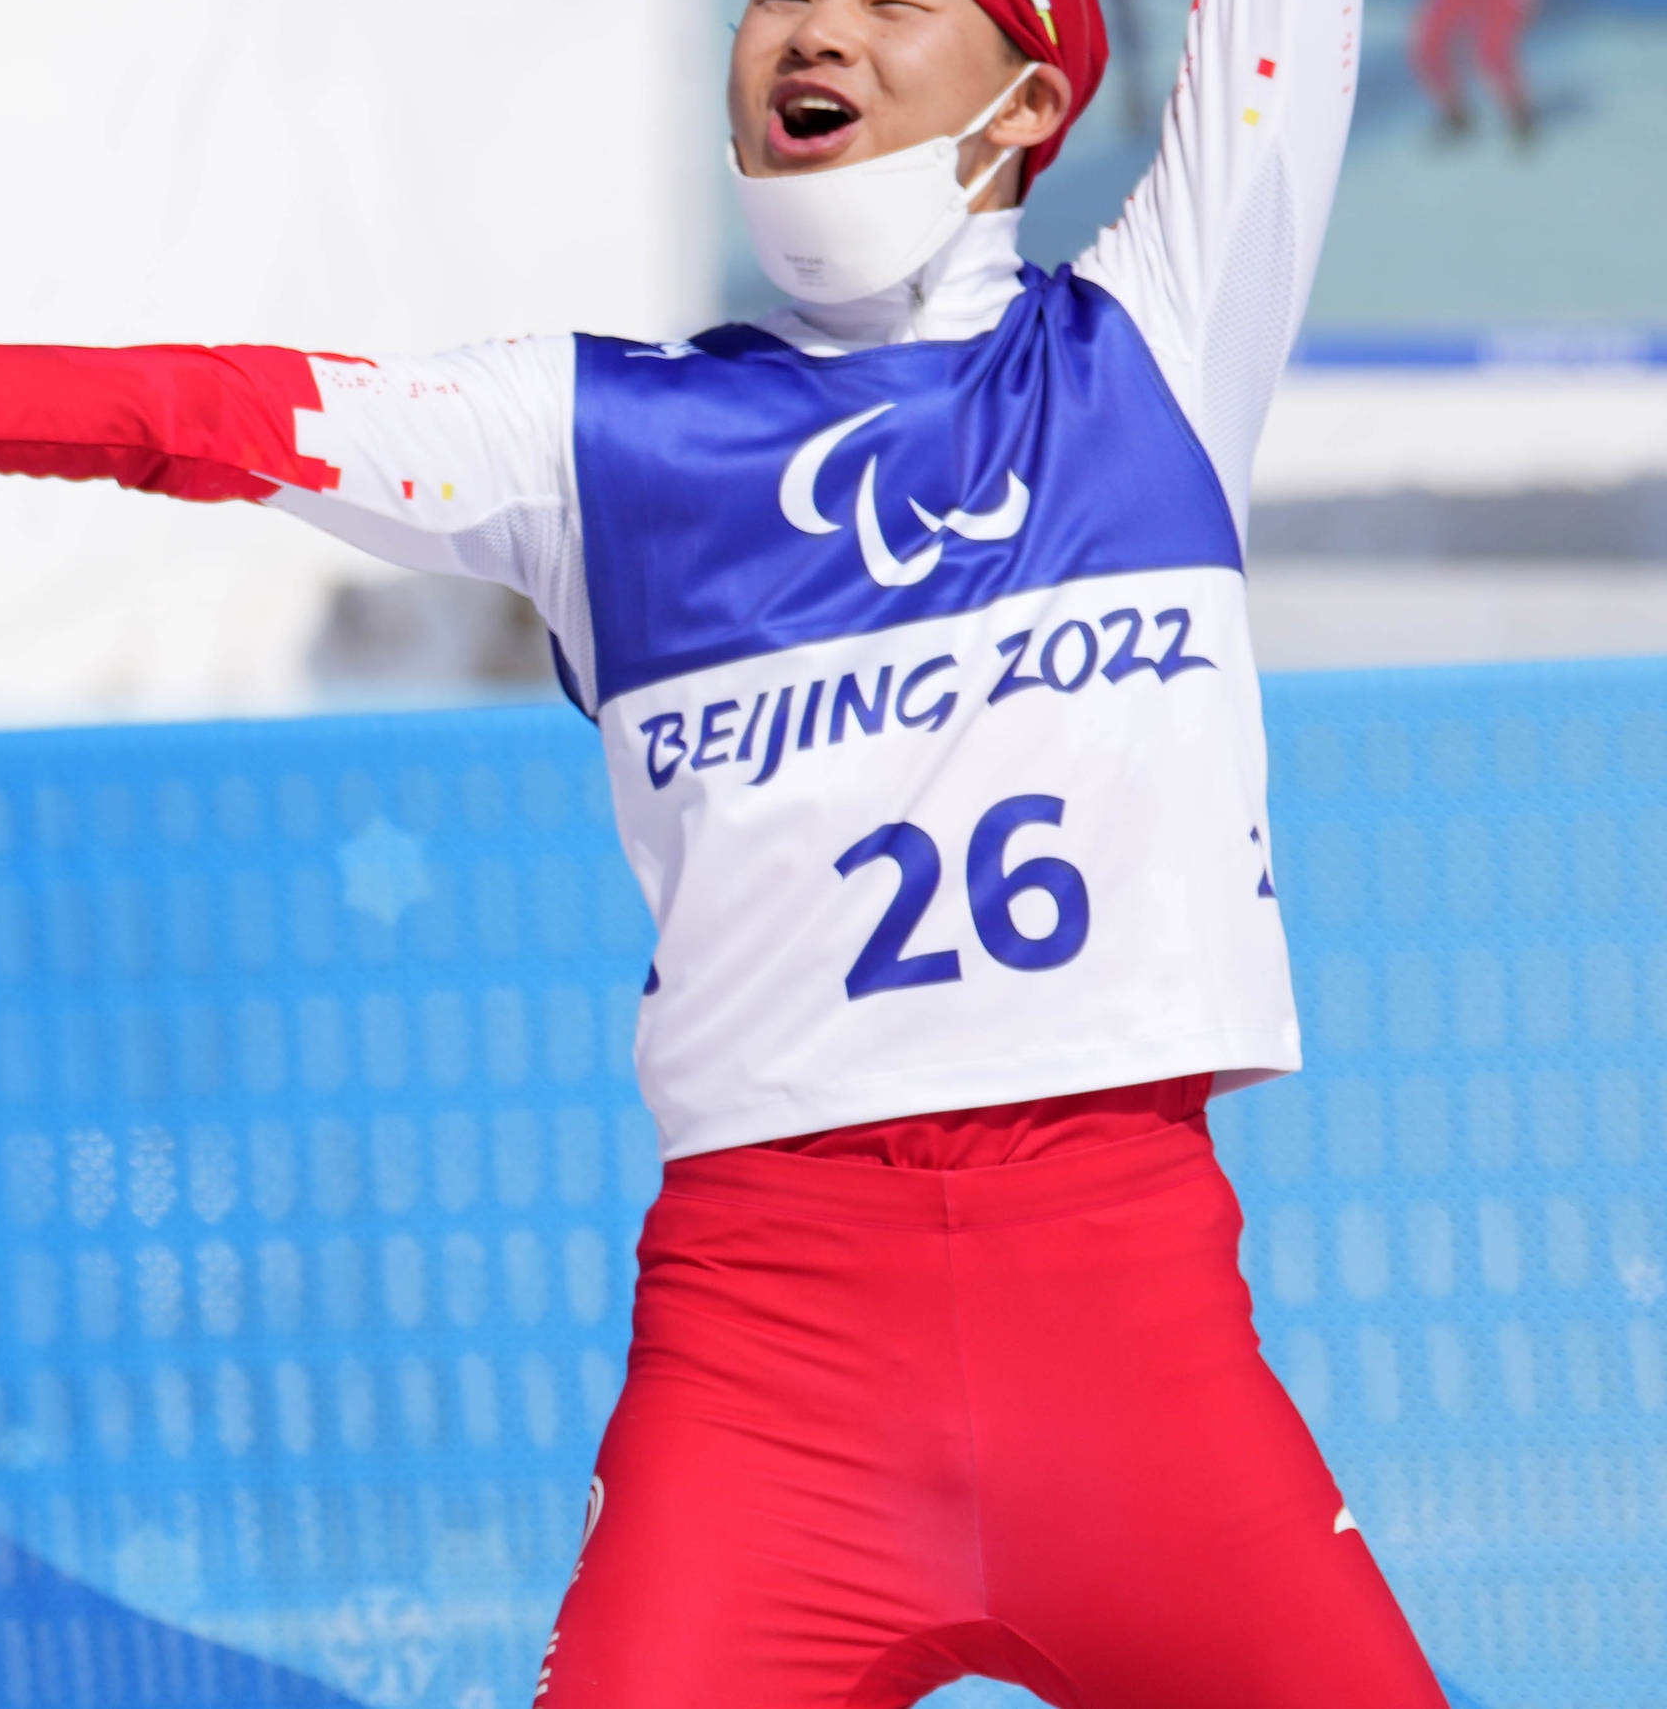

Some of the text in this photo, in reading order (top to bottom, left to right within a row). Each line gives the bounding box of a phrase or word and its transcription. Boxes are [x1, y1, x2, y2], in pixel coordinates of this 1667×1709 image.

[639, 606, 1217, 793] BEIJING 2022
[833, 793, 1091, 1002] 26
